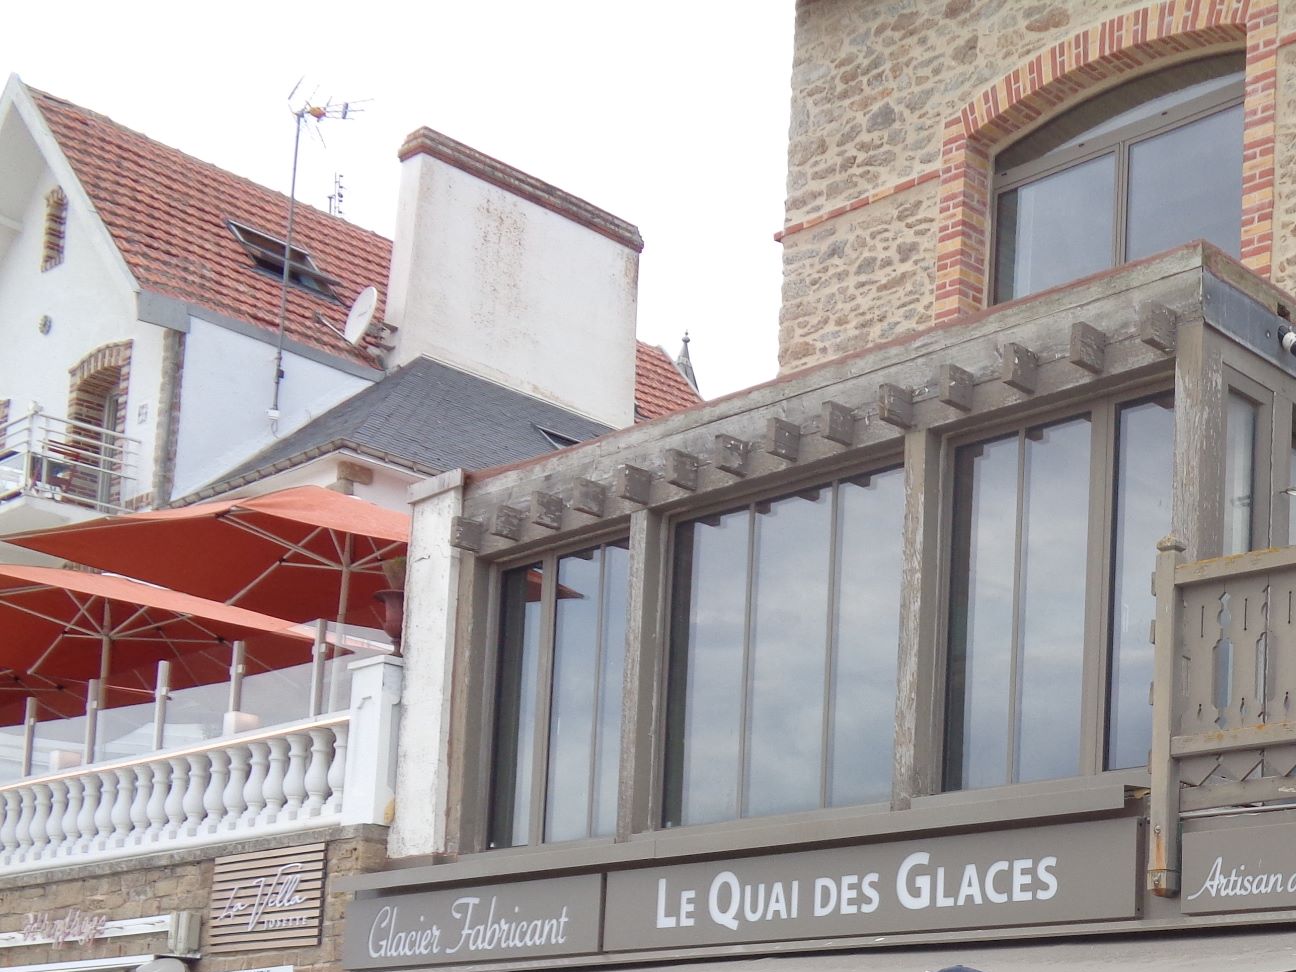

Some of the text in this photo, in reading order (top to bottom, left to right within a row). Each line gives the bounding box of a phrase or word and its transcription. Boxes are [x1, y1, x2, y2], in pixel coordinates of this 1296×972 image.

[218, 887, 248, 921] La
[656, 851, 1059, 931] LE QUAI DES GLACES
[1187, 856, 1284, 900] Artisan
[368, 896, 569, 958] Glacier Fabricant
